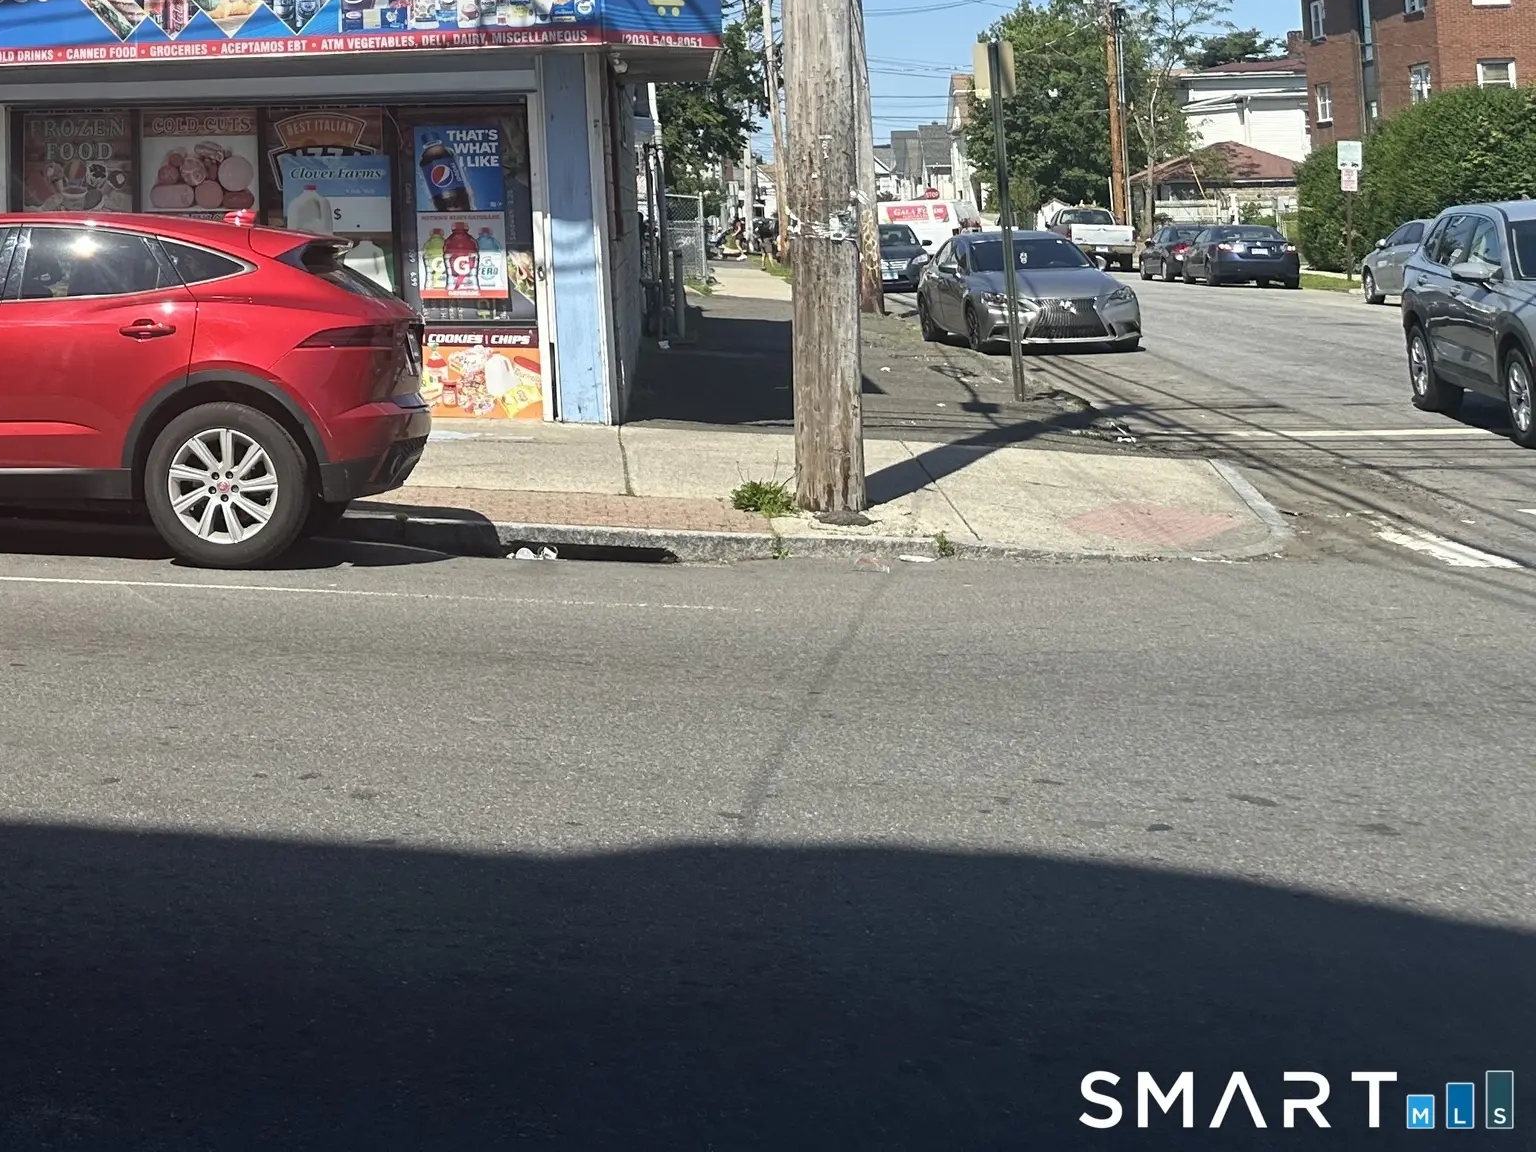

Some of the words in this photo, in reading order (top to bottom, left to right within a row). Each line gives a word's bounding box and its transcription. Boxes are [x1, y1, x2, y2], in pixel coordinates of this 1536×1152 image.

[17, 49, 54, 62] DRINKS
[66, 47, 106, 60] CANNED
[110, 46, 137, 58] FOOD
[150, 44, 208, 57] GROCERIES
[221, 41, 285, 55] ACEPTAMOS
[287, 40, 307, 51] EBT
[321, 38, 344, 50] ATM
[346, 36, 418, 49] VEGETABLES,
[453, 33, 488, 46] DAIRY,
[491, 30, 588, 44] MISCELLANEOUS
[30, 117, 126, 137] FROZEN
[151, 117, 200, 133] COLD
[203, 117, 253, 133] CUTS
[286, 120, 311, 136] BEST
[314, 119, 354, 134] ITALIAN
[446, 129, 498, 141] THAT'S
[45, 142, 114, 161] FOOD
[454, 142, 499, 154] WHAT
[467, 155, 500, 167] LIKE
[290, 167, 336, 180] Clover
[337, 167, 382, 179] Farms
[453, 256, 470, 275] G
[428, 333, 484, 344] COOKIES
[490, 334, 531, 345] CHIPS
